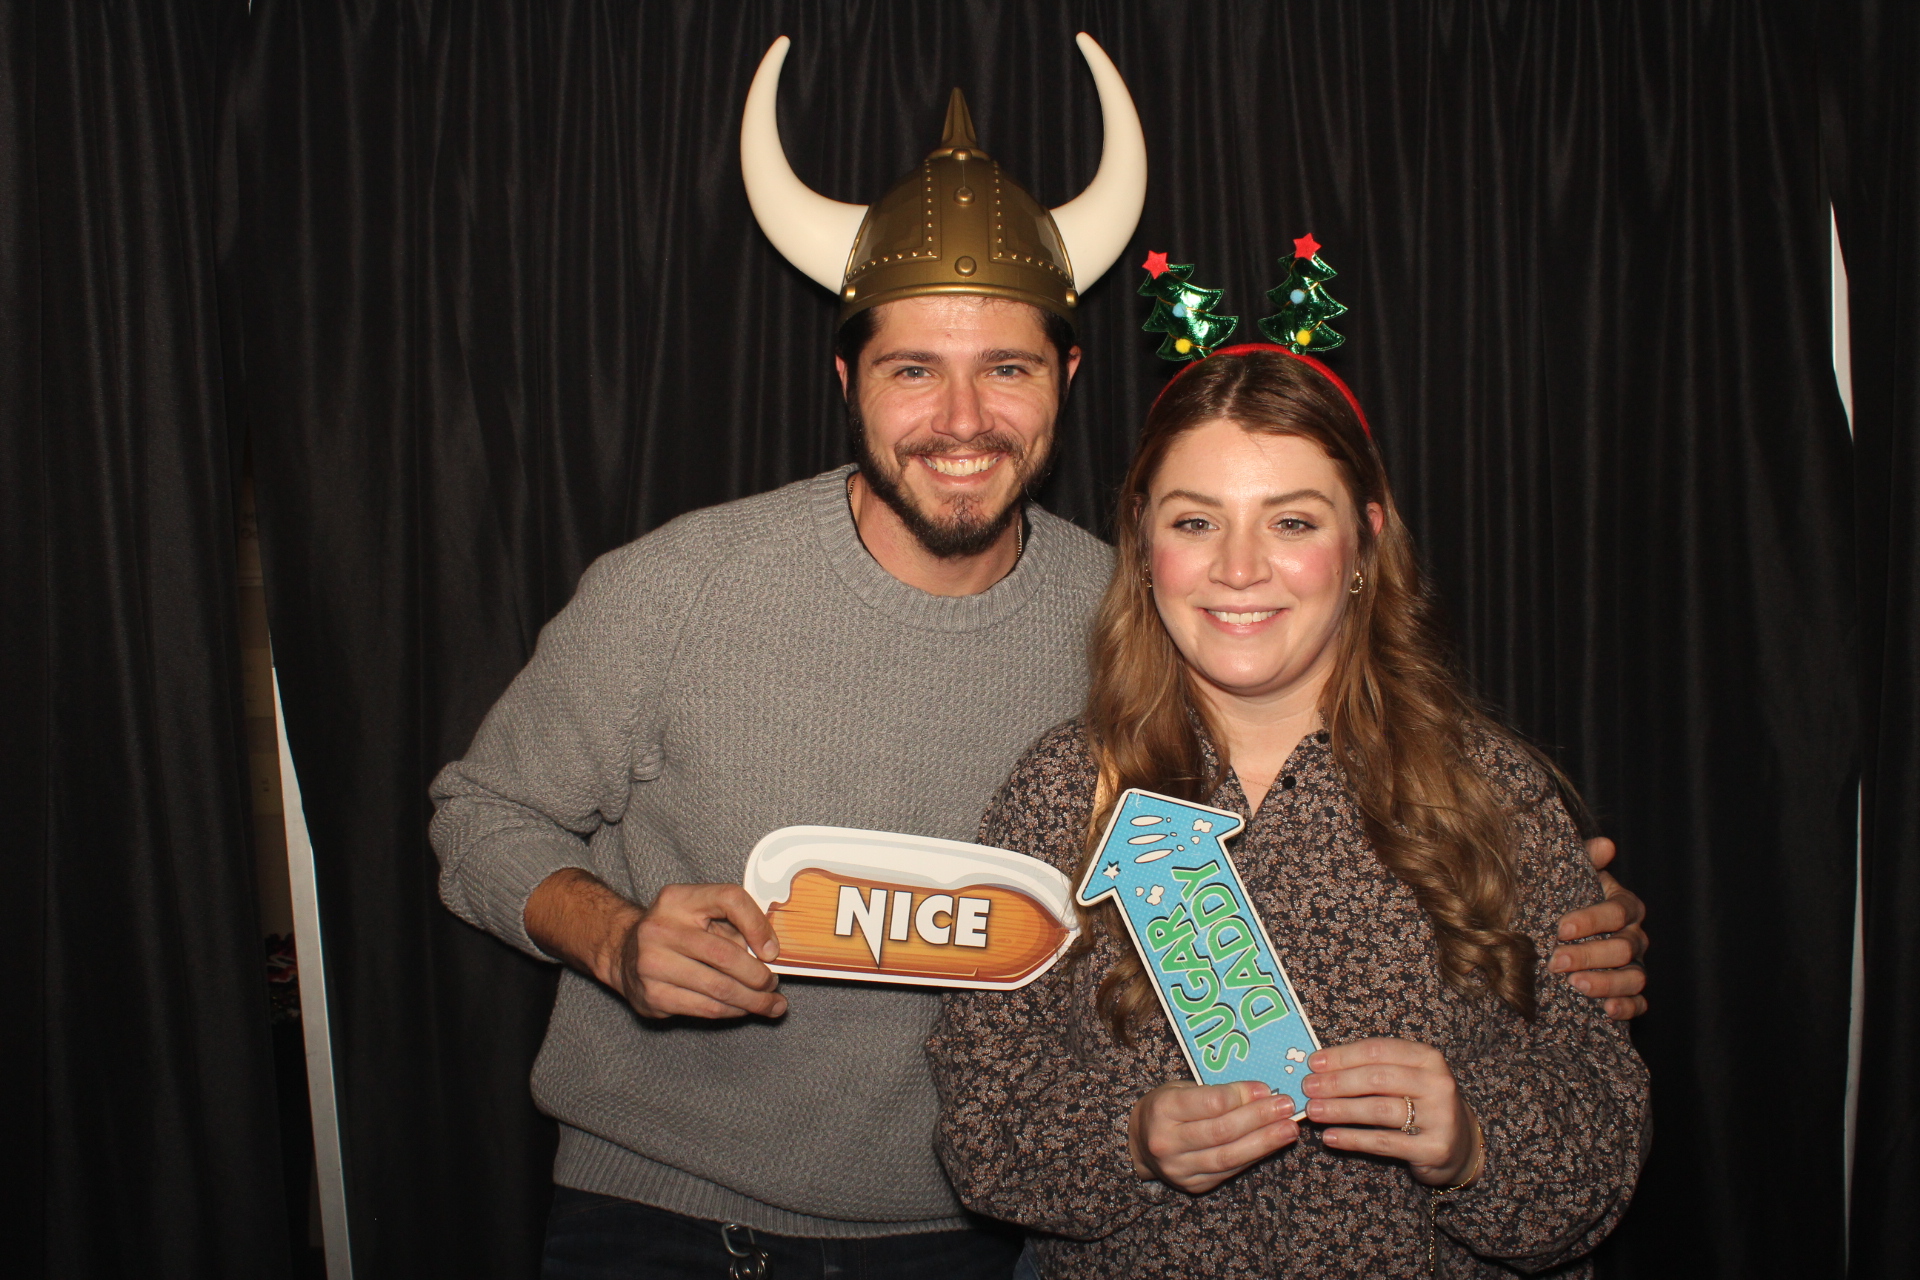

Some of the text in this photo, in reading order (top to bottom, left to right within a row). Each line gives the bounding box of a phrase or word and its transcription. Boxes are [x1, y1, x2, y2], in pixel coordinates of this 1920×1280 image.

[834, 885, 991, 969] NICE
[1145, 903, 1249, 1072] SUGAR
[1171, 860, 1291, 1032] DADDY
